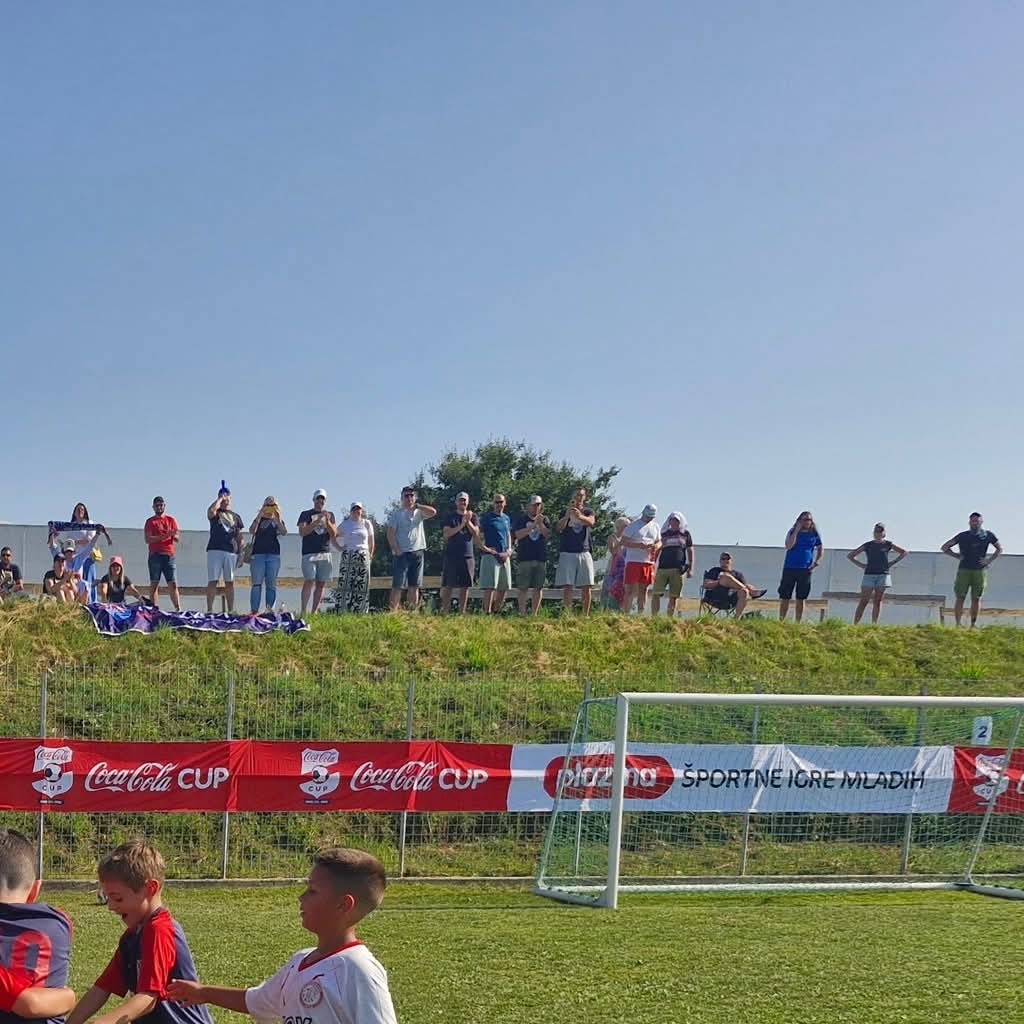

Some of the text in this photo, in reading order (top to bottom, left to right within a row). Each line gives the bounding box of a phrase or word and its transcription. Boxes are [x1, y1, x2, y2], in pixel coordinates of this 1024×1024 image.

[977, 726, 988, 738] 2
[84, 762, 230, 792] Coca-Cola CUP
[350, 761, 489, 791] Coca-Cola CUP
[681, 763, 782, 789] ŠPORTNE
[787, 769, 836, 789] IGRE
[840, 770, 926, 790] MLADIH
